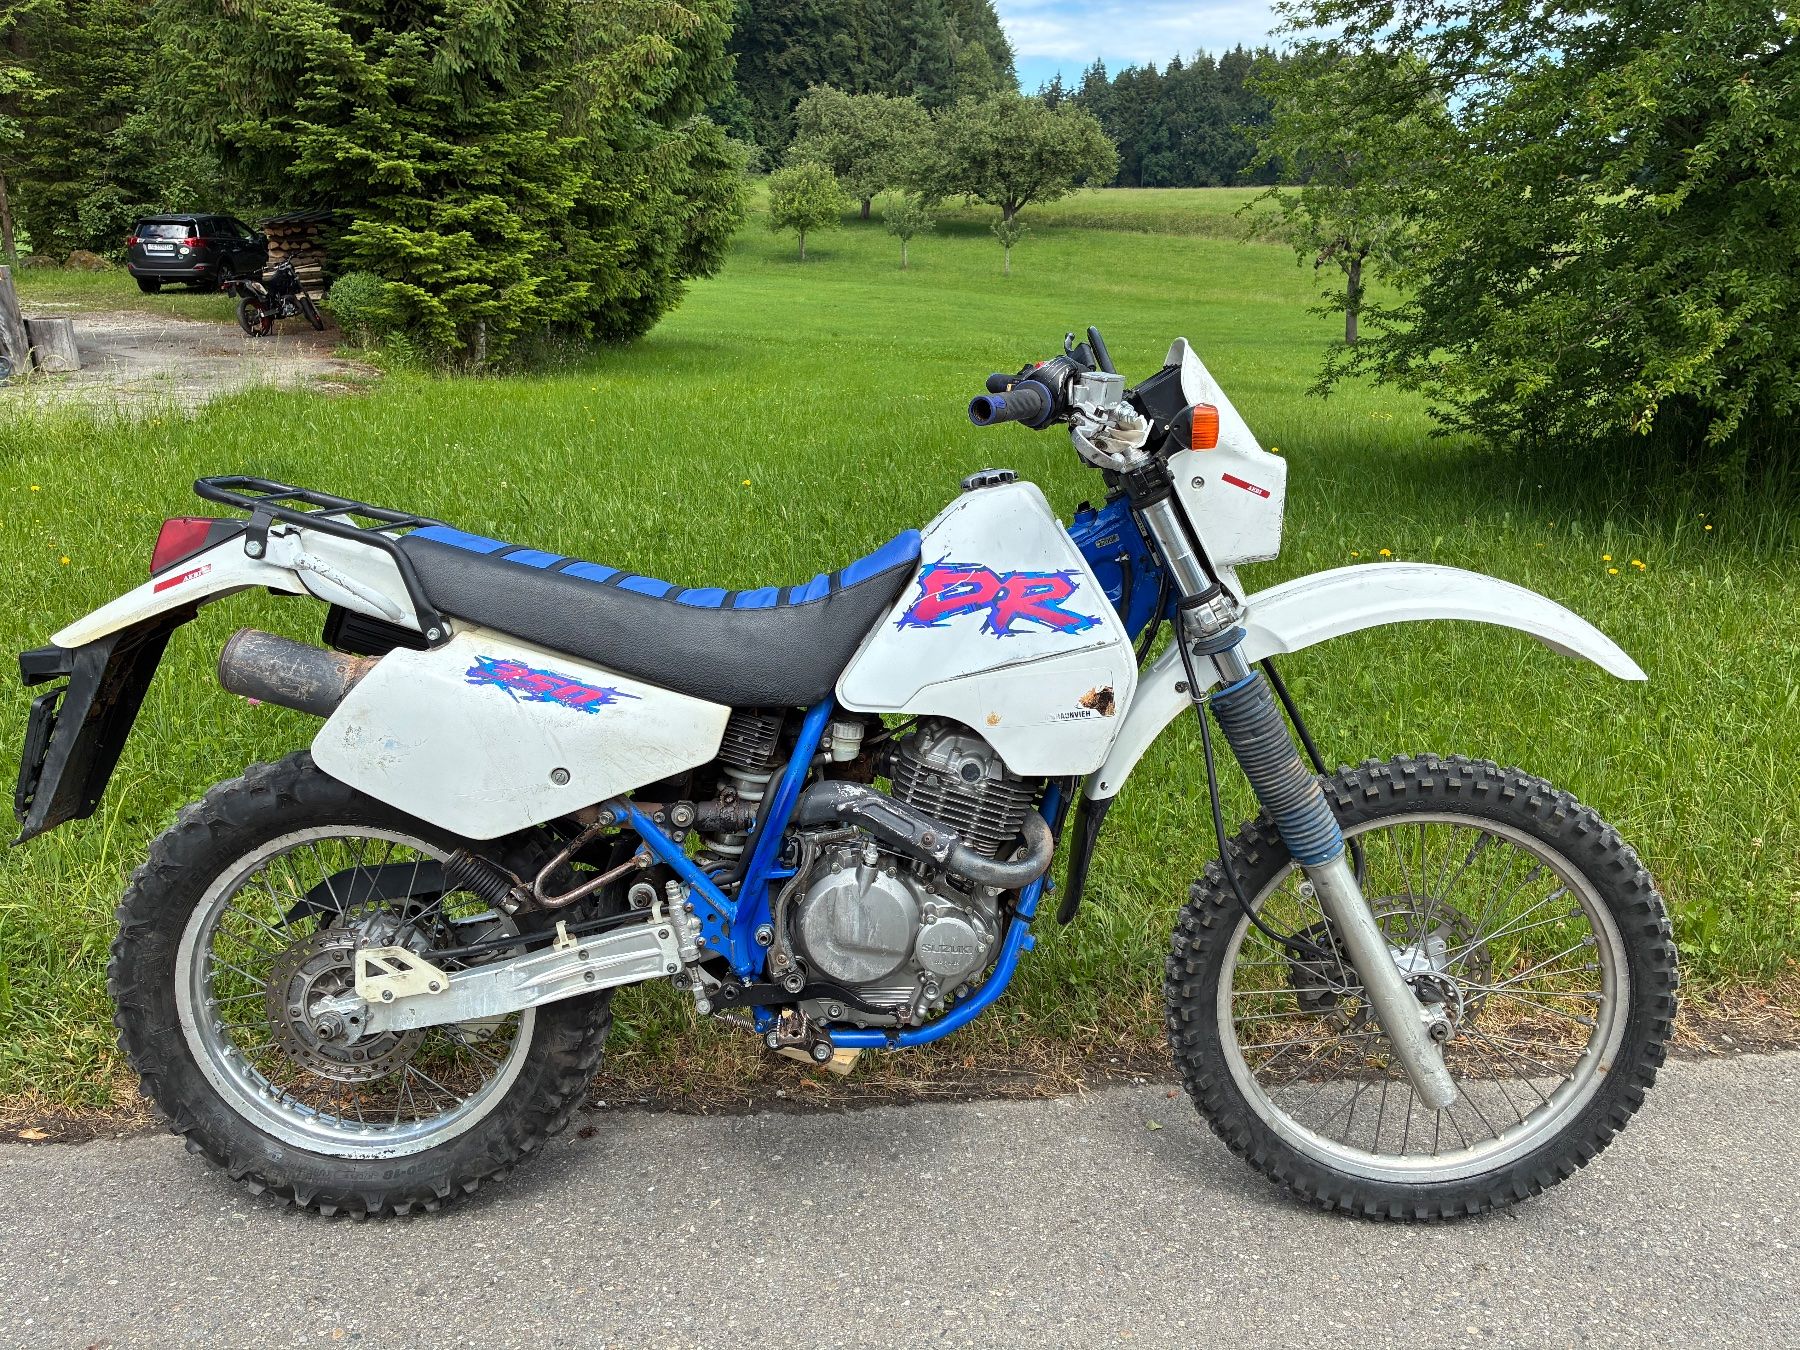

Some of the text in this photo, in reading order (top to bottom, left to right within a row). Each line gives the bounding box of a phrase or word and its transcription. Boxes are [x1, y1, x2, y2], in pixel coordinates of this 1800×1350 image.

[905, 563, 1092, 632] DR
[470, 659, 616, 708] 350
[921, 943, 973, 955] SUZUKI
